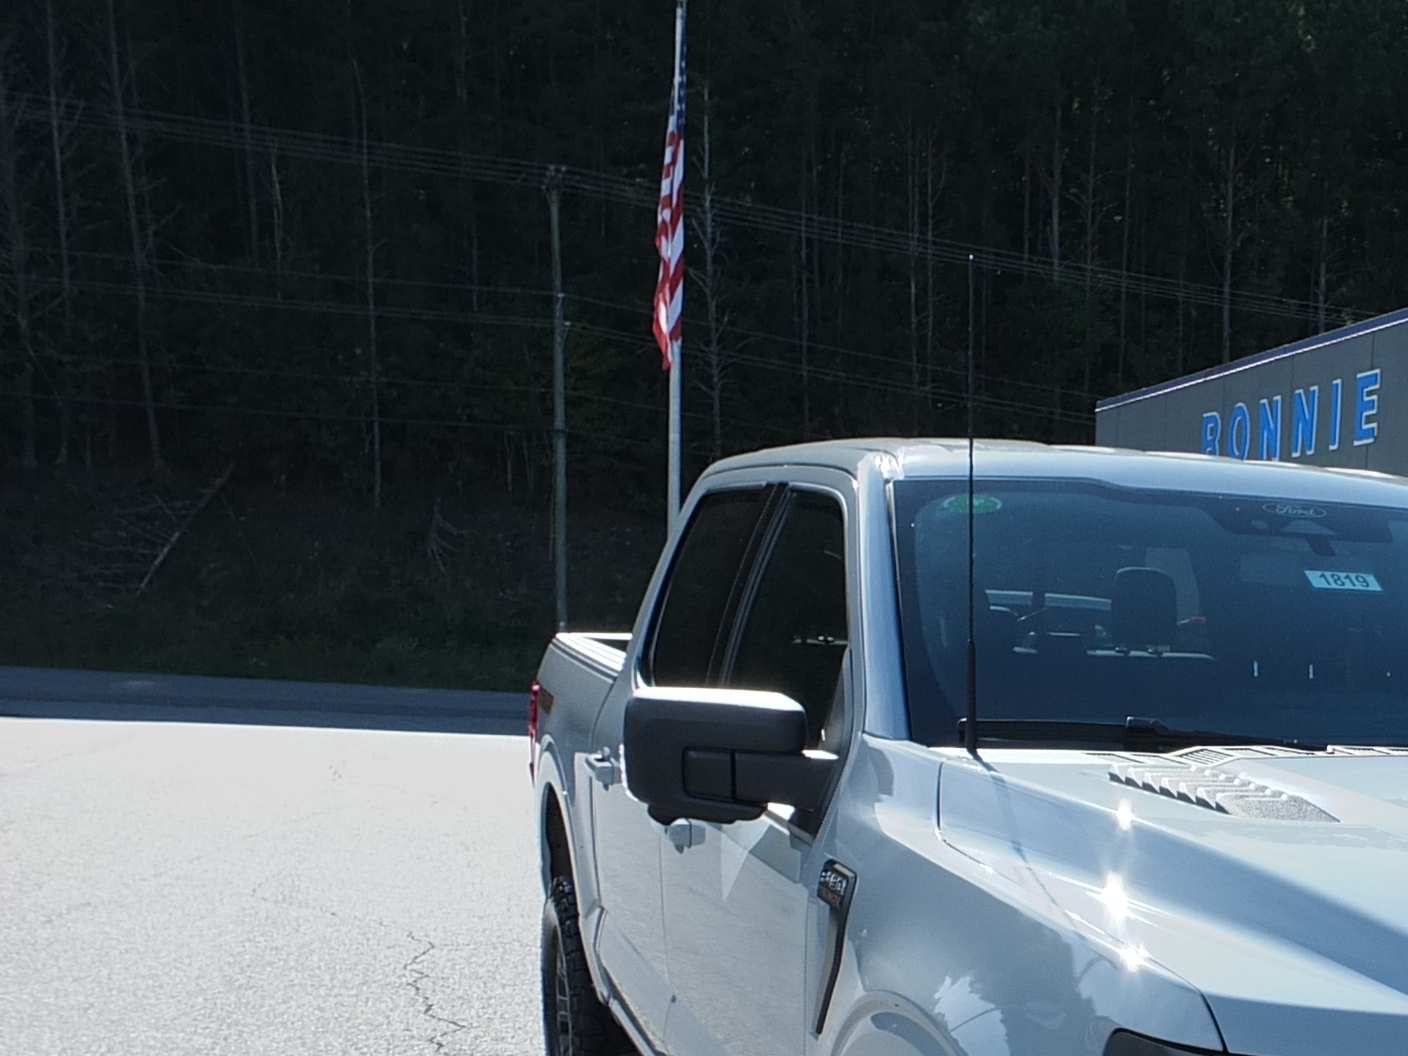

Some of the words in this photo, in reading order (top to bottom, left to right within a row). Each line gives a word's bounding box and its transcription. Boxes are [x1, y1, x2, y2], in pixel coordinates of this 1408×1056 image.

[1201, 368, 1381, 462] RONNIE
[1275, 503, 1316, 517] Ford
[1319, 572, 1370, 588] 1819
